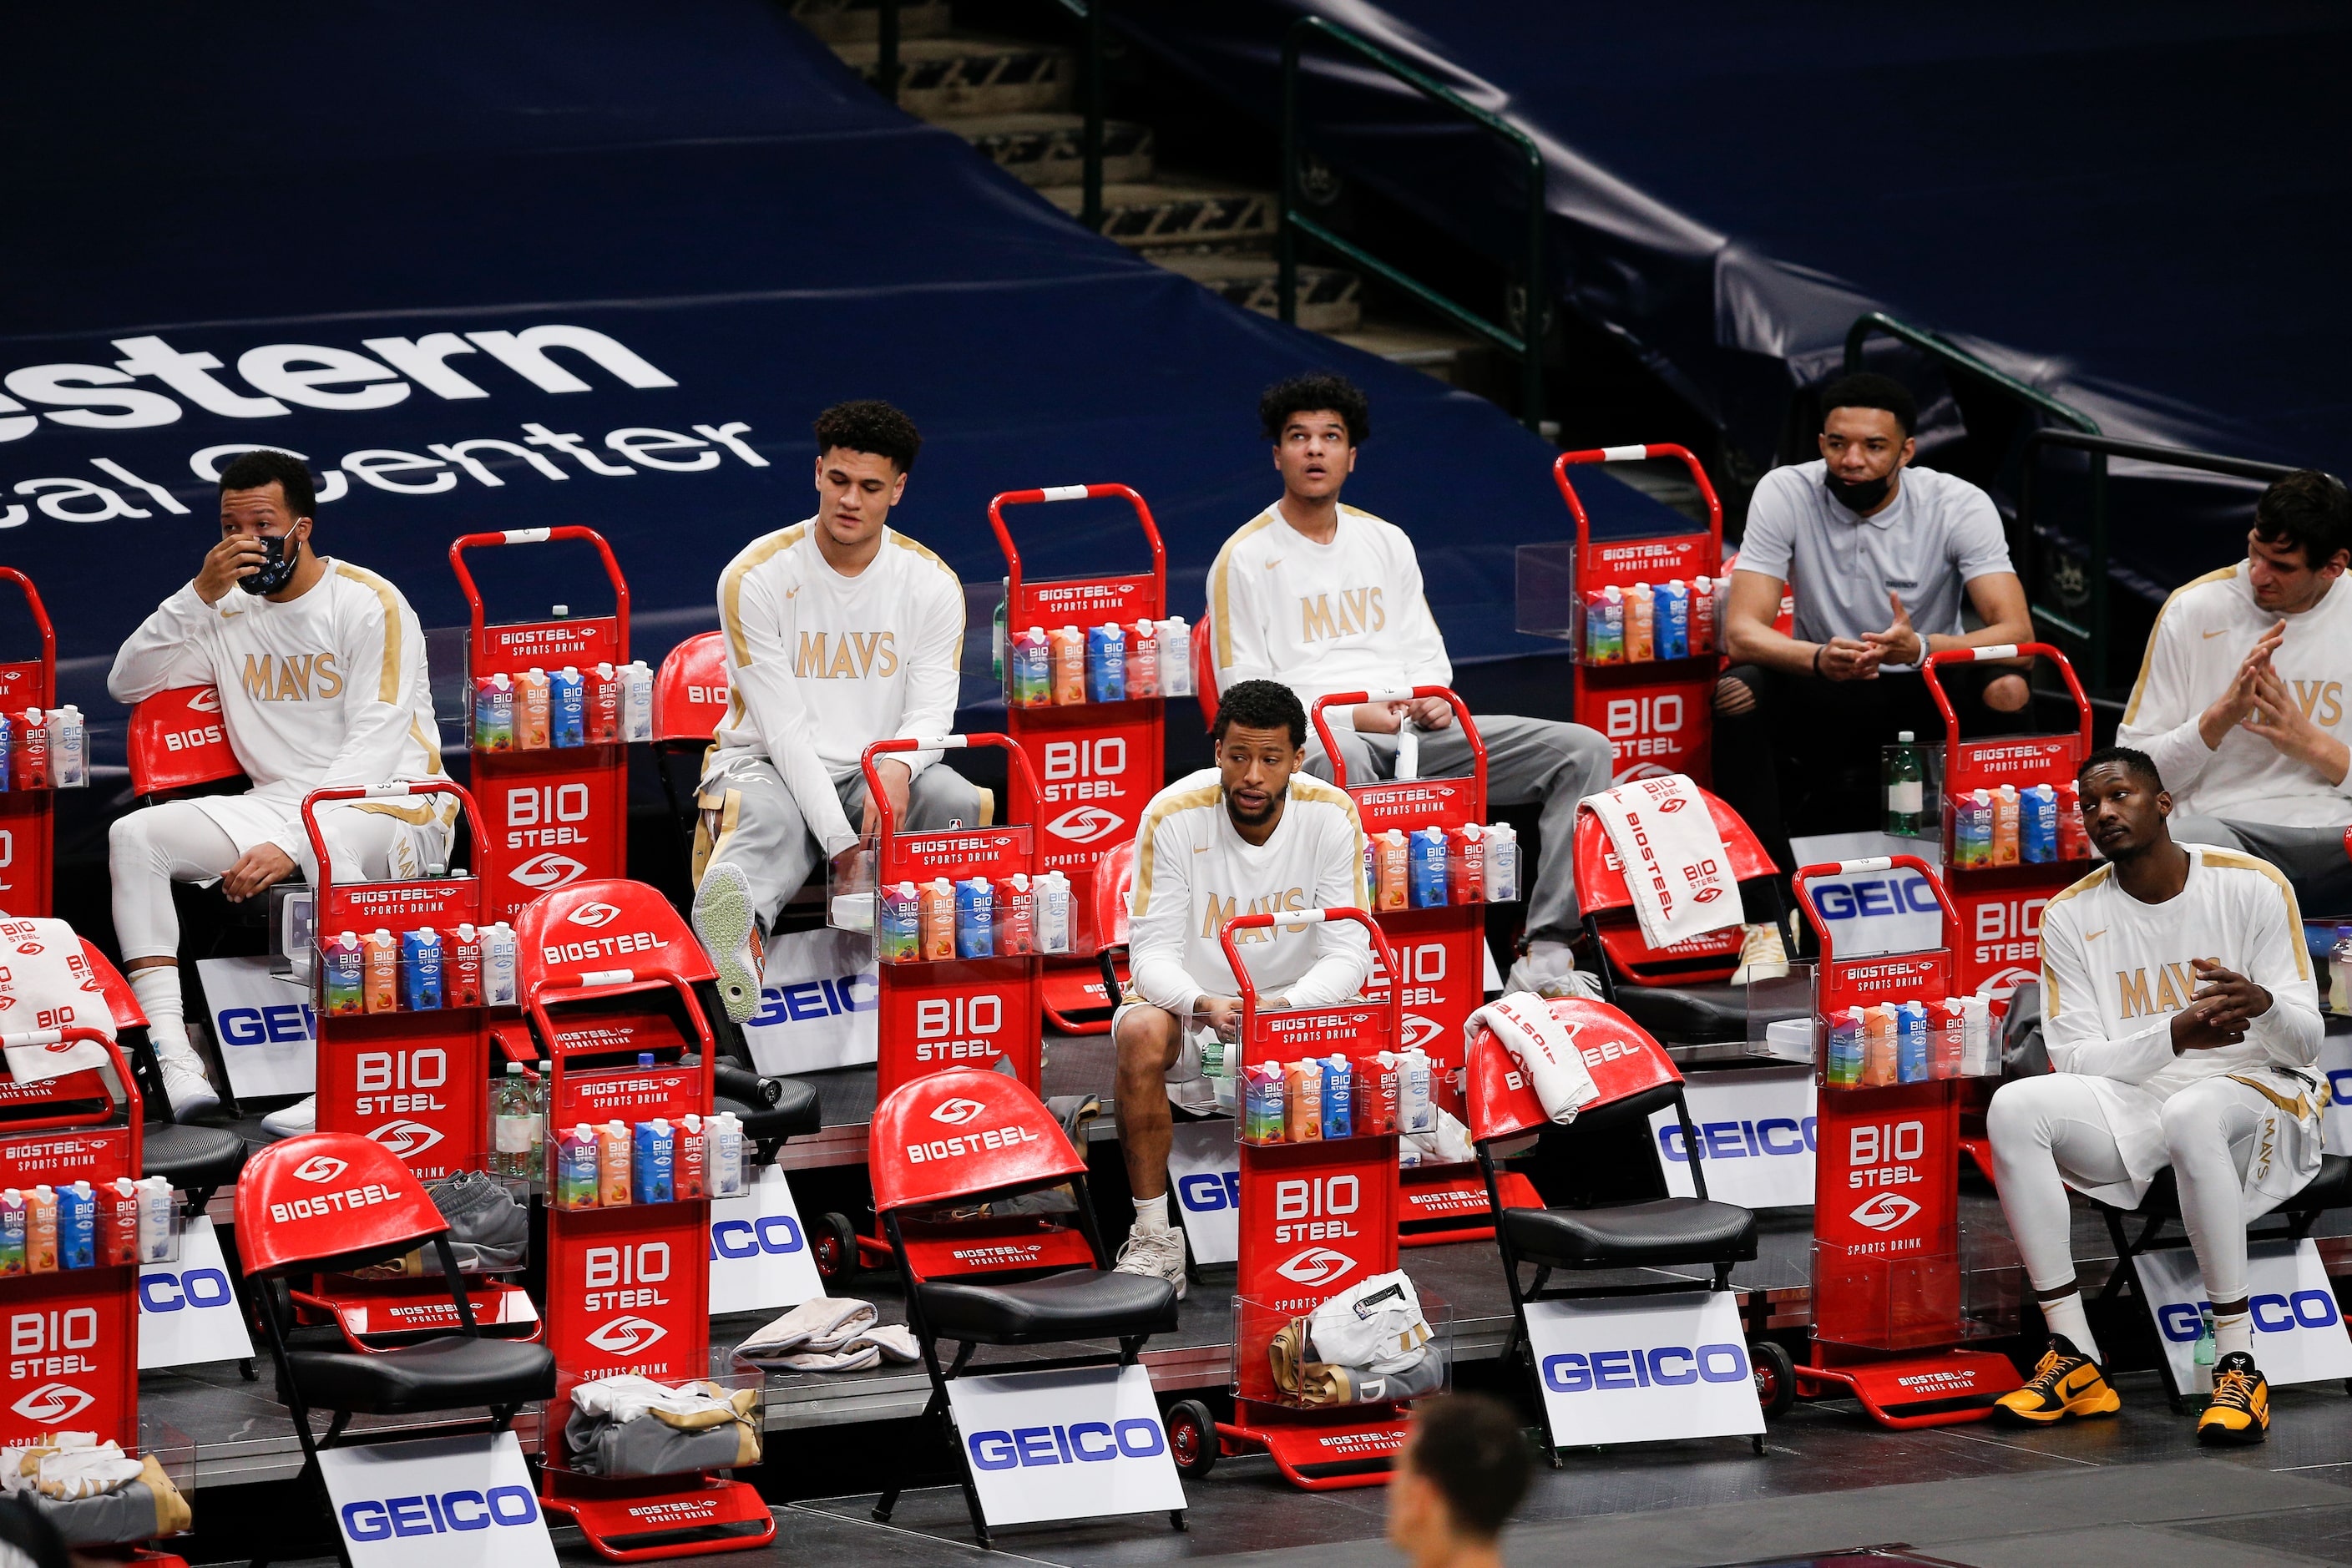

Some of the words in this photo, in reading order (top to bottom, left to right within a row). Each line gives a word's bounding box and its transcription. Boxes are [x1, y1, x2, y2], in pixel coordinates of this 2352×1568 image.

[0, 324, 679, 443] stern
[189, 422, 770, 503] Center
[1603, 544, 1672, 560] BIOSTEEL
[1613, 560, 1648, 572] SPORTS
[1039, 585, 1114, 601] BIOSTEEL
[1050, 601, 1088, 613] SPORTS
[1093, 598, 1123, 609] DRINK
[1300, 587, 1385, 643] MAVS
[501, 629, 576, 645] BIOSTEEL
[513, 644, 550, 656] SPORTS
[555, 641, 585, 653] DRINK
[1029, 647, 1048, 657] BIO
[1104, 642, 1123, 652] BIO
[795, 631, 898, 680] MAVS
[241, 653, 343, 701] MAVS
[564, 687, 582, 698] BIO
[599, 683, 617, 693] BIO
[493, 693, 512, 703] BIO
[1607, 695, 1683, 737] BIO
[27, 729, 45, 739] BIO
[164, 725, 226, 752] BIOS
[1611, 737, 1682, 759] STEEL
[1973, 746, 2042, 761] BIOSTEEL
[1045, 737, 1125, 780] BIO
[1984, 761, 2018, 773] SPORTS
[2022, 758, 2051, 769] DRINK
[1044, 780, 1125, 802] STEEL
[1641, 778, 1677, 794] BIO
[1363, 789, 1435, 806] BIOSTEEL
[1651, 788, 1682, 801] STEEL
[508, 783, 589, 827] BIO
[1373, 805, 1409, 817] SPORTS
[1415, 802, 1444, 813] DRINK
[2039, 805, 2056, 815] BIO
[1974, 809, 1991, 819] BIO
[506, 827, 589, 848] STEEL
[912, 837, 990, 853] BIOSTEEL
[1388, 850, 1407, 859] BIO
[1427, 847, 1445, 857] BIO
[1464, 844, 1483, 854] BIO
[923, 854, 962, 866] SPORTS
[969, 851, 999, 862] DRINK
[1044, 853, 1085, 866] SPORTS
[1626, 812, 1673, 921] BIOSTEEL
[1683, 859, 1717, 882] BIO
[1690, 877, 1719, 889] STEEL
[351, 888, 434, 903] BIOSTEEL
[973, 897, 992, 907] BIO
[364, 904, 405, 916] SPORTS
[411, 901, 444, 913] DRINK
[898, 902, 918, 912] BIO
[0, 921, 36, 936] BIO
[8, 933, 40, 943] STEEL
[418, 948, 439, 959] BIO
[458, 945, 478, 956] BIO
[543, 932, 670, 965] BIOSTEEL
[339, 953, 361, 964] BIO
[1848, 963, 1915, 980] BIOSTEEL
[1858, 979, 1891, 992] SPORTS
[1896, 975, 1923, 988] DRINK
[37, 1006, 75, 1028] BIO
[917, 995, 1002, 1039] BIO
[1272, 1014, 1348, 1031] BIOSTEEL
[1946, 1018, 1962, 1029] BIO
[1910, 1020, 1927, 1031] BIO
[564, 1039, 599, 1049] SPORTS
[603, 1037, 630, 1046] DRINK
[1283, 1031, 1321, 1044] SPORTS
[1326, 1027, 1358, 1039] DRINK
[916, 1039, 1002, 1061] STEEL
[357, 1048, 447, 1092] BIO
[581, 1079, 660, 1096] BIOSTEEL
[1264, 1082, 1283, 1093] BIO
[1331, 1075, 1350, 1085] BIO
[356, 1093, 447, 1115] STEEL
[594, 1095, 632, 1108] SPORTS
[637, 1092, 669, 1104] DRINK
[6, 1141, 85, 1160] BIOSTEEL
[653, 1140, 673, 1151] BIO
[907, 1125, 1039, 1164] BIOSTEEL
[1850, 1120, 1924, 1166] BIO
[2257, 1117, 2275, 1181] MAVS
[575, 1146, 596, 1156] BIO
[18, 1159, 58, 1171] SPORTS
[63, 1154, 96, 1166] DRINK
[1849, 1166, 1924, 1189] STEEL
[270, 1183, 402, 1223] BIOSTEEL
[1276, 1174, 1359, 1220] BIO
[1409, 1191, 1477, 1204] BIOSTEEL
[75, 1203, 94, 1214] BIO
[117, 1201, 137, 1211] BIO
[1425, 1201, 1459, 1211] SPORTS
[1275, 1221, 1359, 1243] STEEL
[953, 1246, 1024, 1259] BIOSTEEL
[1848, 1242, 1885, 1256] SPORTS
[1890, 1237, 1921, 1251] DRINK
[586, 1242, 670, 1288] BIO
[969, 1256, 1004, 1266] SPORTS
[1009, 1253, 1038, 1262] DRINK
[584, 1288, 670, 1312] STEEL
[1275, 1297, 1317, 1312] SPORTS
[406, 1313, 443, 1323] SPORTS
[11, 1308, 97, 1356] BIO
[9, 1355, 97, 1379] STEEL
[584, 1366, 627, 1380] SPORTS
[1542, 1343, 1748, 1393] GEICO
[1898, 1372, 1961, 1386] BIOSTEEL
[1914, 1383, 1946, 1393] SPORTS
[1949, 1380, 1974, 1390] DRINK
[969, 1418, 1165, 1470] GEICO
[1319, 1433, 1389, 1447] BIOSTEEL
[1336, 1444, 1371, 1454] SPORTS
[1374, 1440, 1403, 1450] DRINK
[341, 1485, 538, 1542] GEICO
[628, 1502, 701, 1517] BIOSTEEL
[645, 1513, 681, 1524] SPORTS
[685, 1510, 715, 1520] DRINK
